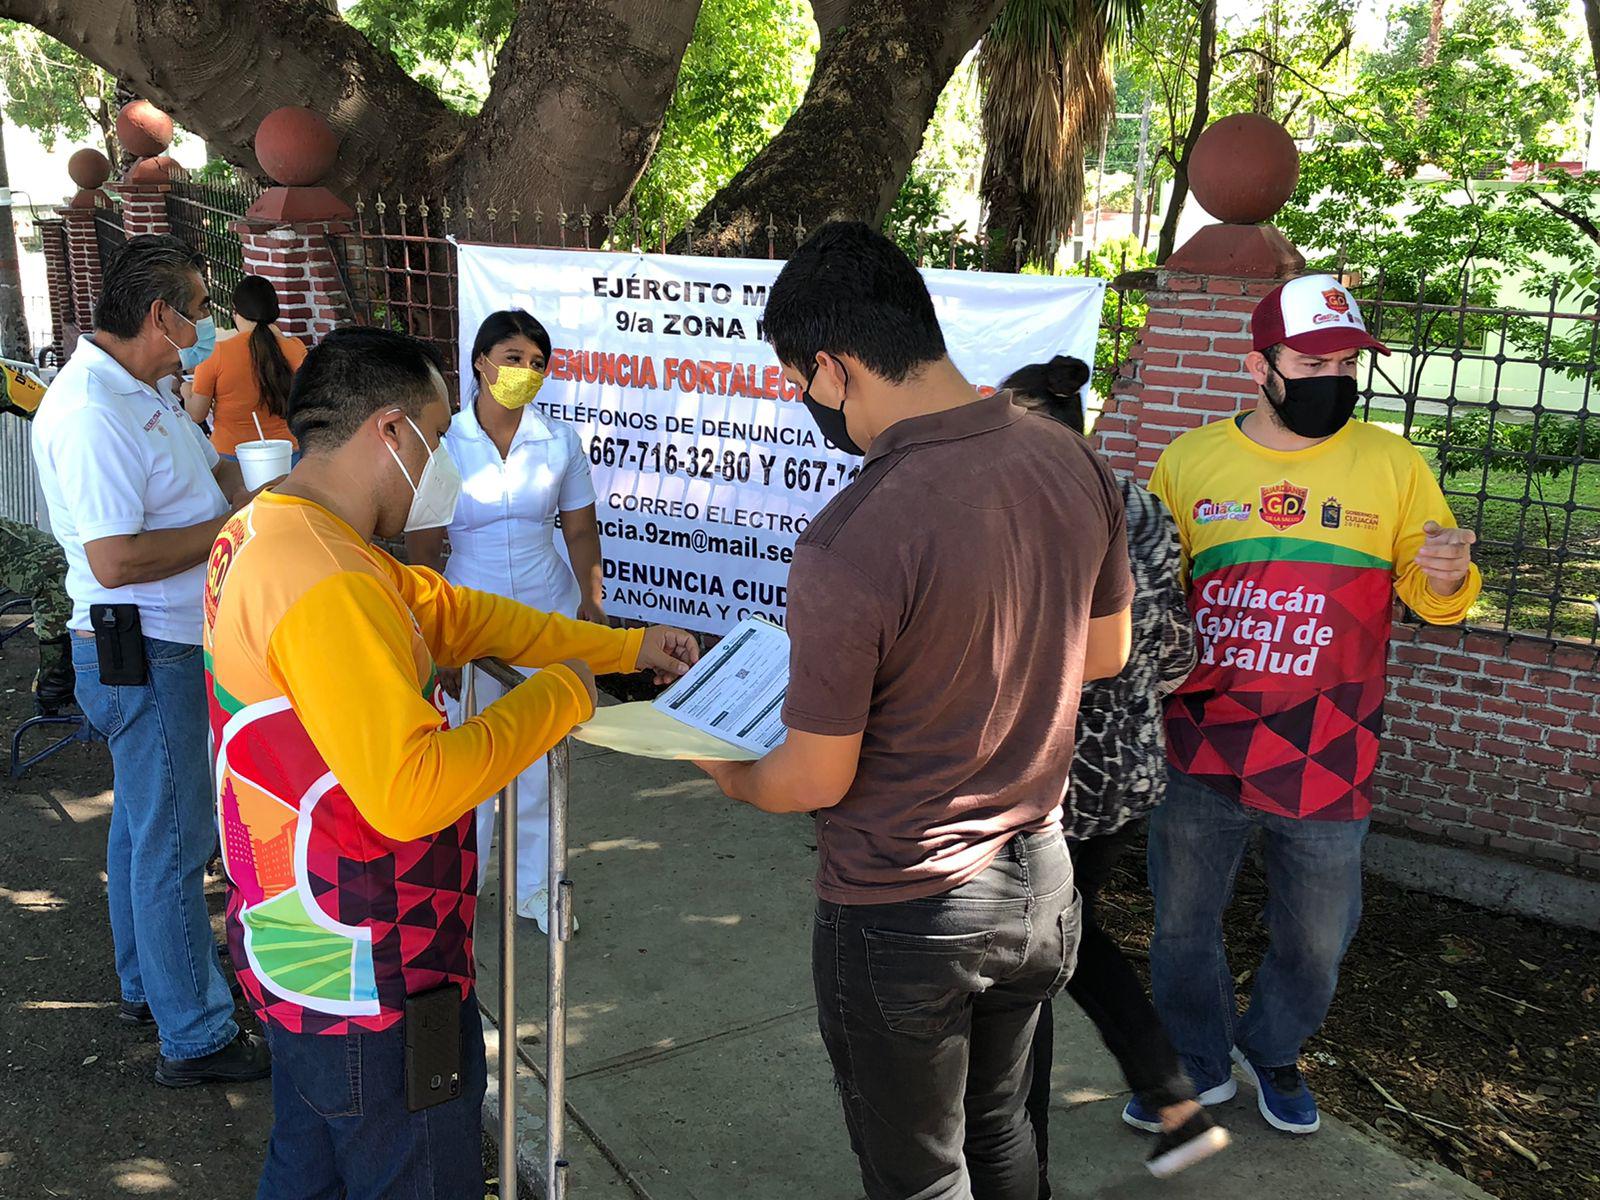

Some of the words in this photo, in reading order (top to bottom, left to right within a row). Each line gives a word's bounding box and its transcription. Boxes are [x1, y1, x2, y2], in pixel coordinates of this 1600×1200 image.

[593, 273, 732, 304] EJÉRCITO
[616, 310, 653, 333] 9/a
[663, 314, 746, 339] ZONA
[544, 348, 657, 389] ENUNCIA
[537, 402, 657, 431] TELÉFONOS
[666, 416, 694, 434] DE
[702, 419, 816, 448] DENUNCIA
[589, 435, 750, 483] 667-716-32-80
[759, 454, 776, 486] Y
[608, 493, 699, 520] CORREO
[707, 506, 809, 534] ELECTRÓ
[603, 558, 724, 597] DENUNCIA
[1202, 579, 1325, 614] Culiacán
[613, 586, 711, 618] ANÓNIMA
[716, 604, 730, 620] Y
[1196, 607, 1286, 643] Capital
[1293, 617, 1333, 646] de
[1219, 642, 1319, 676] salud
